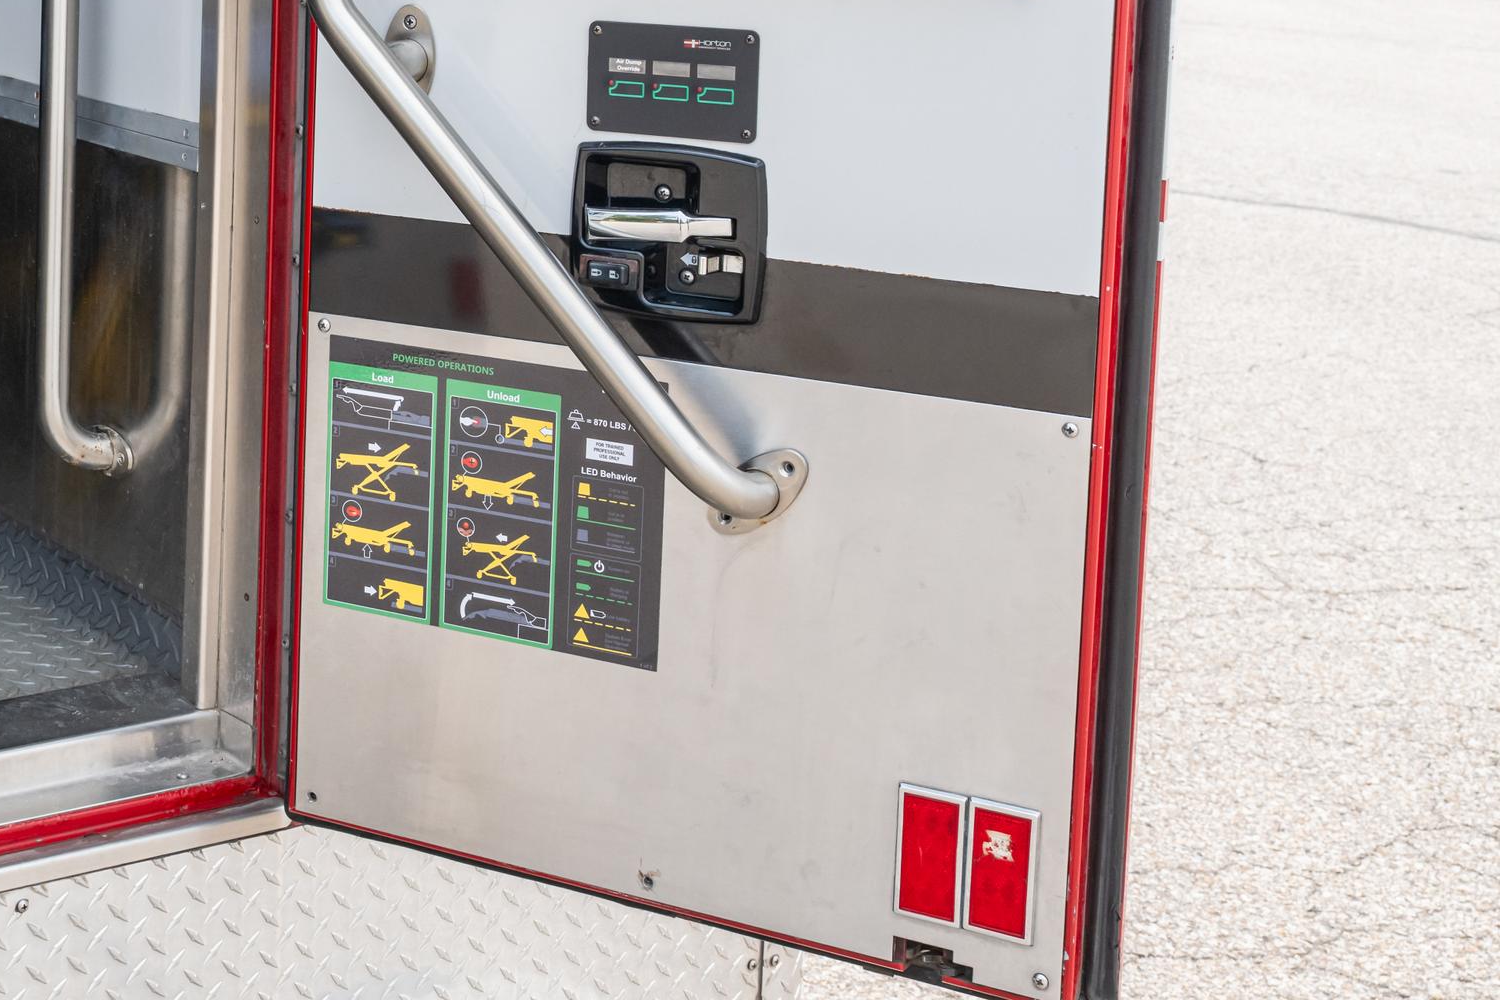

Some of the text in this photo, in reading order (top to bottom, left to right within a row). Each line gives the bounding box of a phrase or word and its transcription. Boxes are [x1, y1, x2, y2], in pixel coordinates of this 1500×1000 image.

[392, 353, 495, 376] POWERED OPERATIONS
[371, 372, 394, 384] Load
[487, 390, 521, 403] Unload
[593, 418, 608, 427] 870
[609, 421, 627, 431] LBS
[593, 447, 626, 457] PROFESSIONAL
[605, 443, 624, 451] TRAINED
[581, 466, 637, 483] LED Behavior
